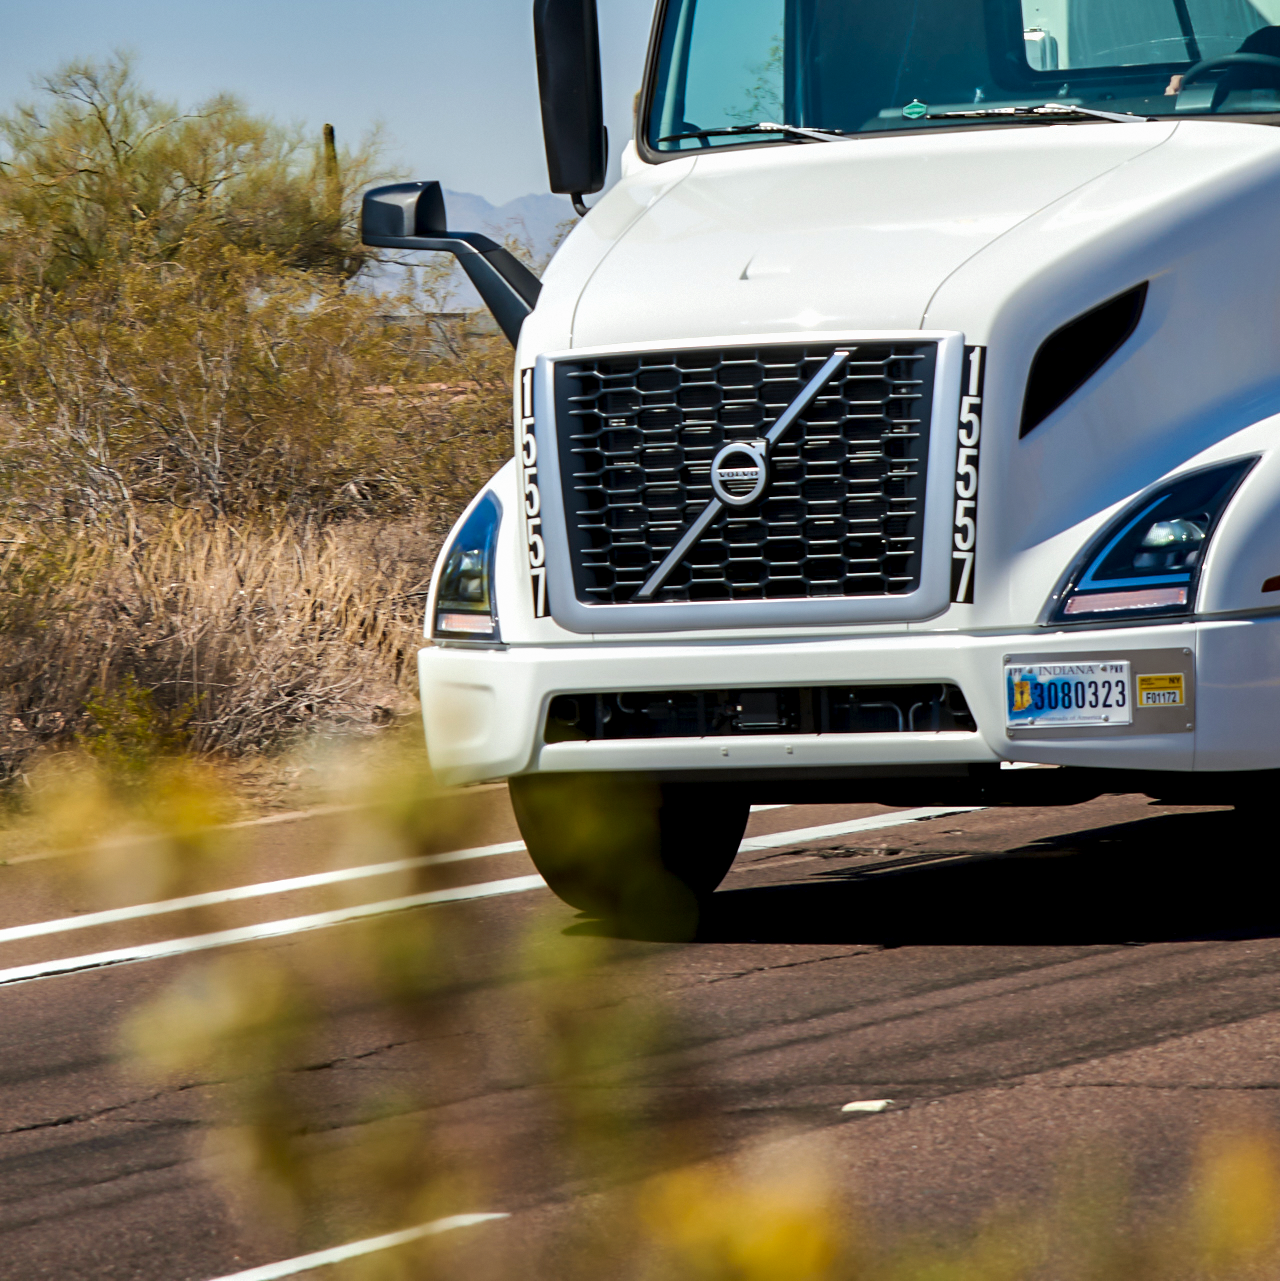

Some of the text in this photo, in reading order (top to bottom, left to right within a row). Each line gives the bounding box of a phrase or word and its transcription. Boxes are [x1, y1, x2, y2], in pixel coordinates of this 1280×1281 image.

[953, 347, 982, 603] 15557
[522, 369, 548, 616] 15557
[1039, 666, 1095, 676] INDIANA
[1168, 676, 1180, 684] NY
[1034, 680, 1126, 710] 3080323
[1146, 691, 1177, 703] F01172
